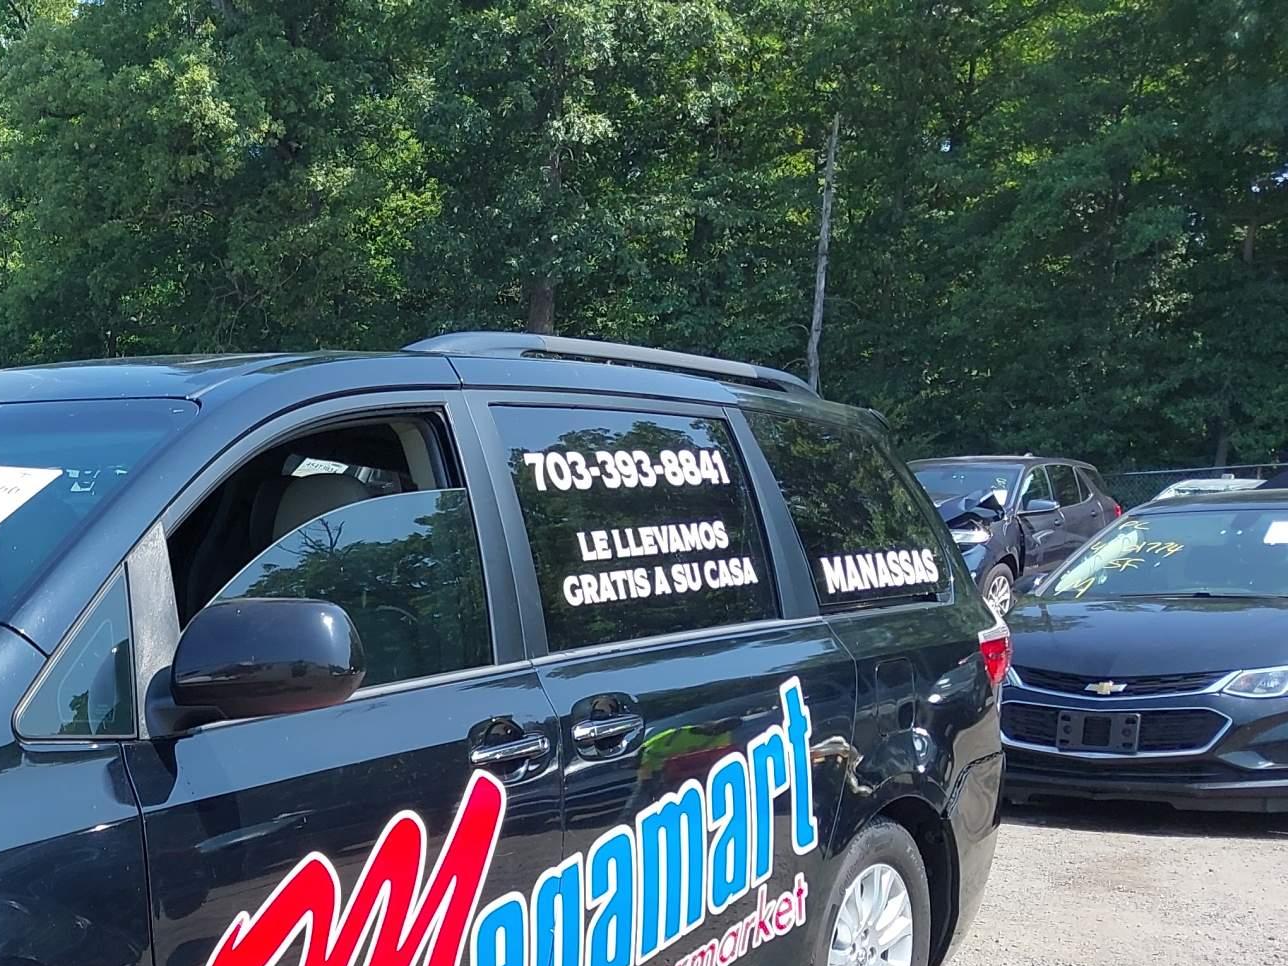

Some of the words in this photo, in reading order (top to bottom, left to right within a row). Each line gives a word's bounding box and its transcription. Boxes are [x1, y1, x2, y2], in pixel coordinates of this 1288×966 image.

[523, 450, 731, 491] 703-393-8841
[576, 529, 612, 562] LE
[611, 520, 730, 558] LLEVAMOS
[563, 567, 652, 607] GRATIS
[654, 566, 672, 595] A
[671, 562, 703, 593] SU
[703, 556, 759, 589] CASA
[819, 548, 939, 595] MANASSAS
